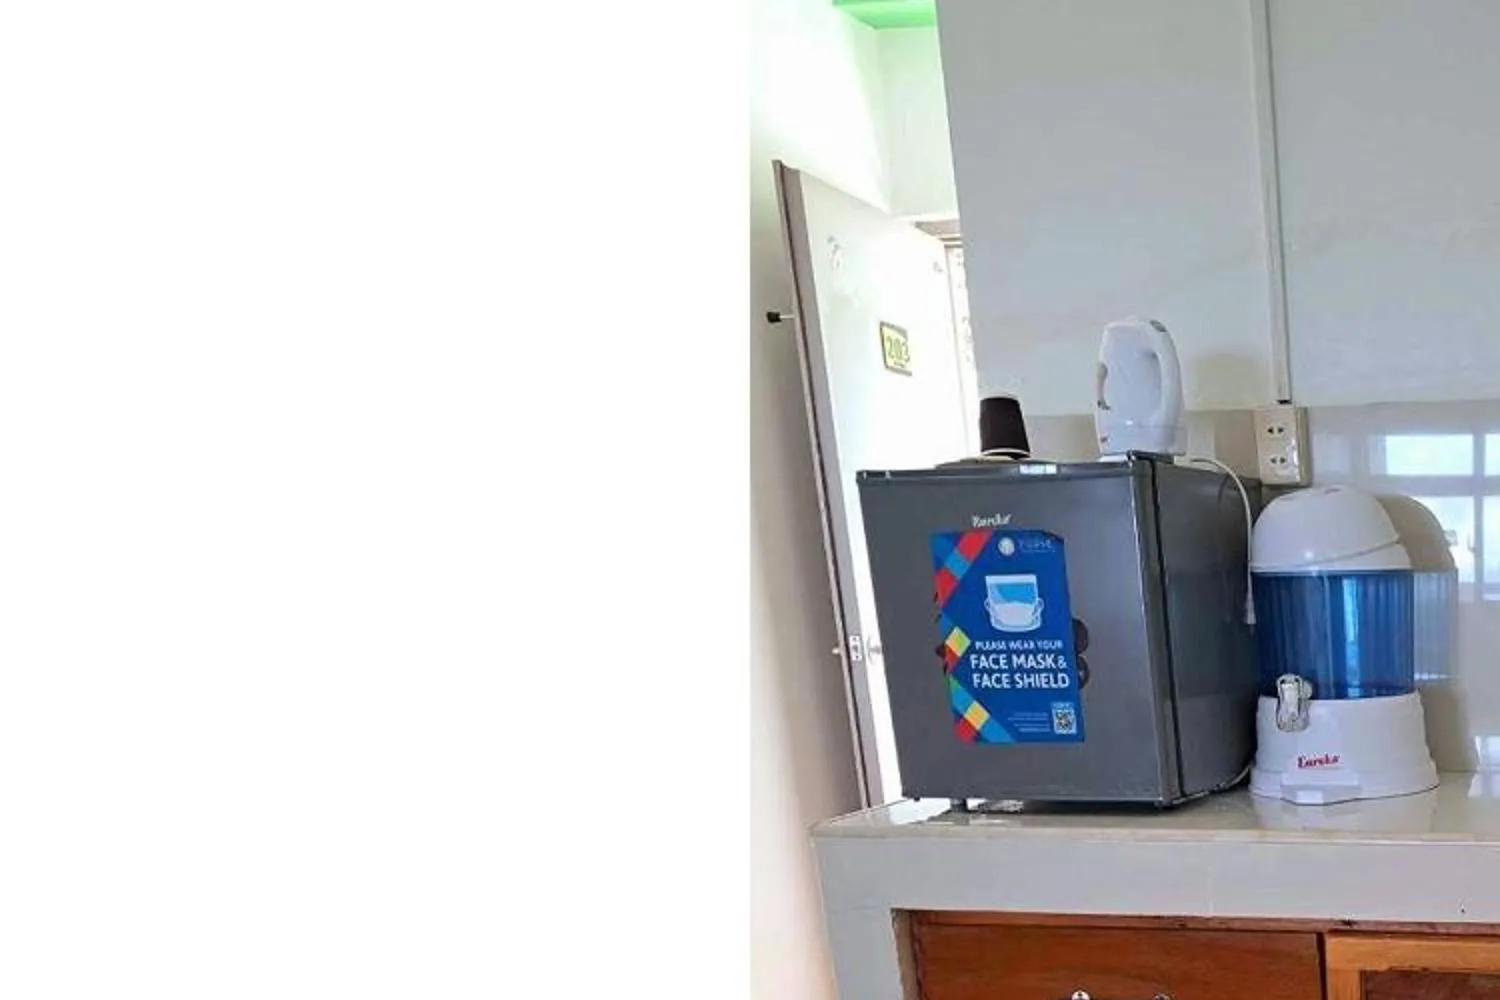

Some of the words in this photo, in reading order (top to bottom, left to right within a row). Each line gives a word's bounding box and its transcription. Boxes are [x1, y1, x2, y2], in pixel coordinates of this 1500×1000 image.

[886, 335, 910, 363] 203
[1008, 640, 1035, 650] WEAR
[1036, 640, 1063, 650] YOUR
[969, 653, 1008, 669] FACE
[1011, 654, 1056, 669] MASK
[1056, 655, 1067, 669] &
[972, 673, 1011, 688] FACE
[1014, 672, 1070, 688] SHIELD
